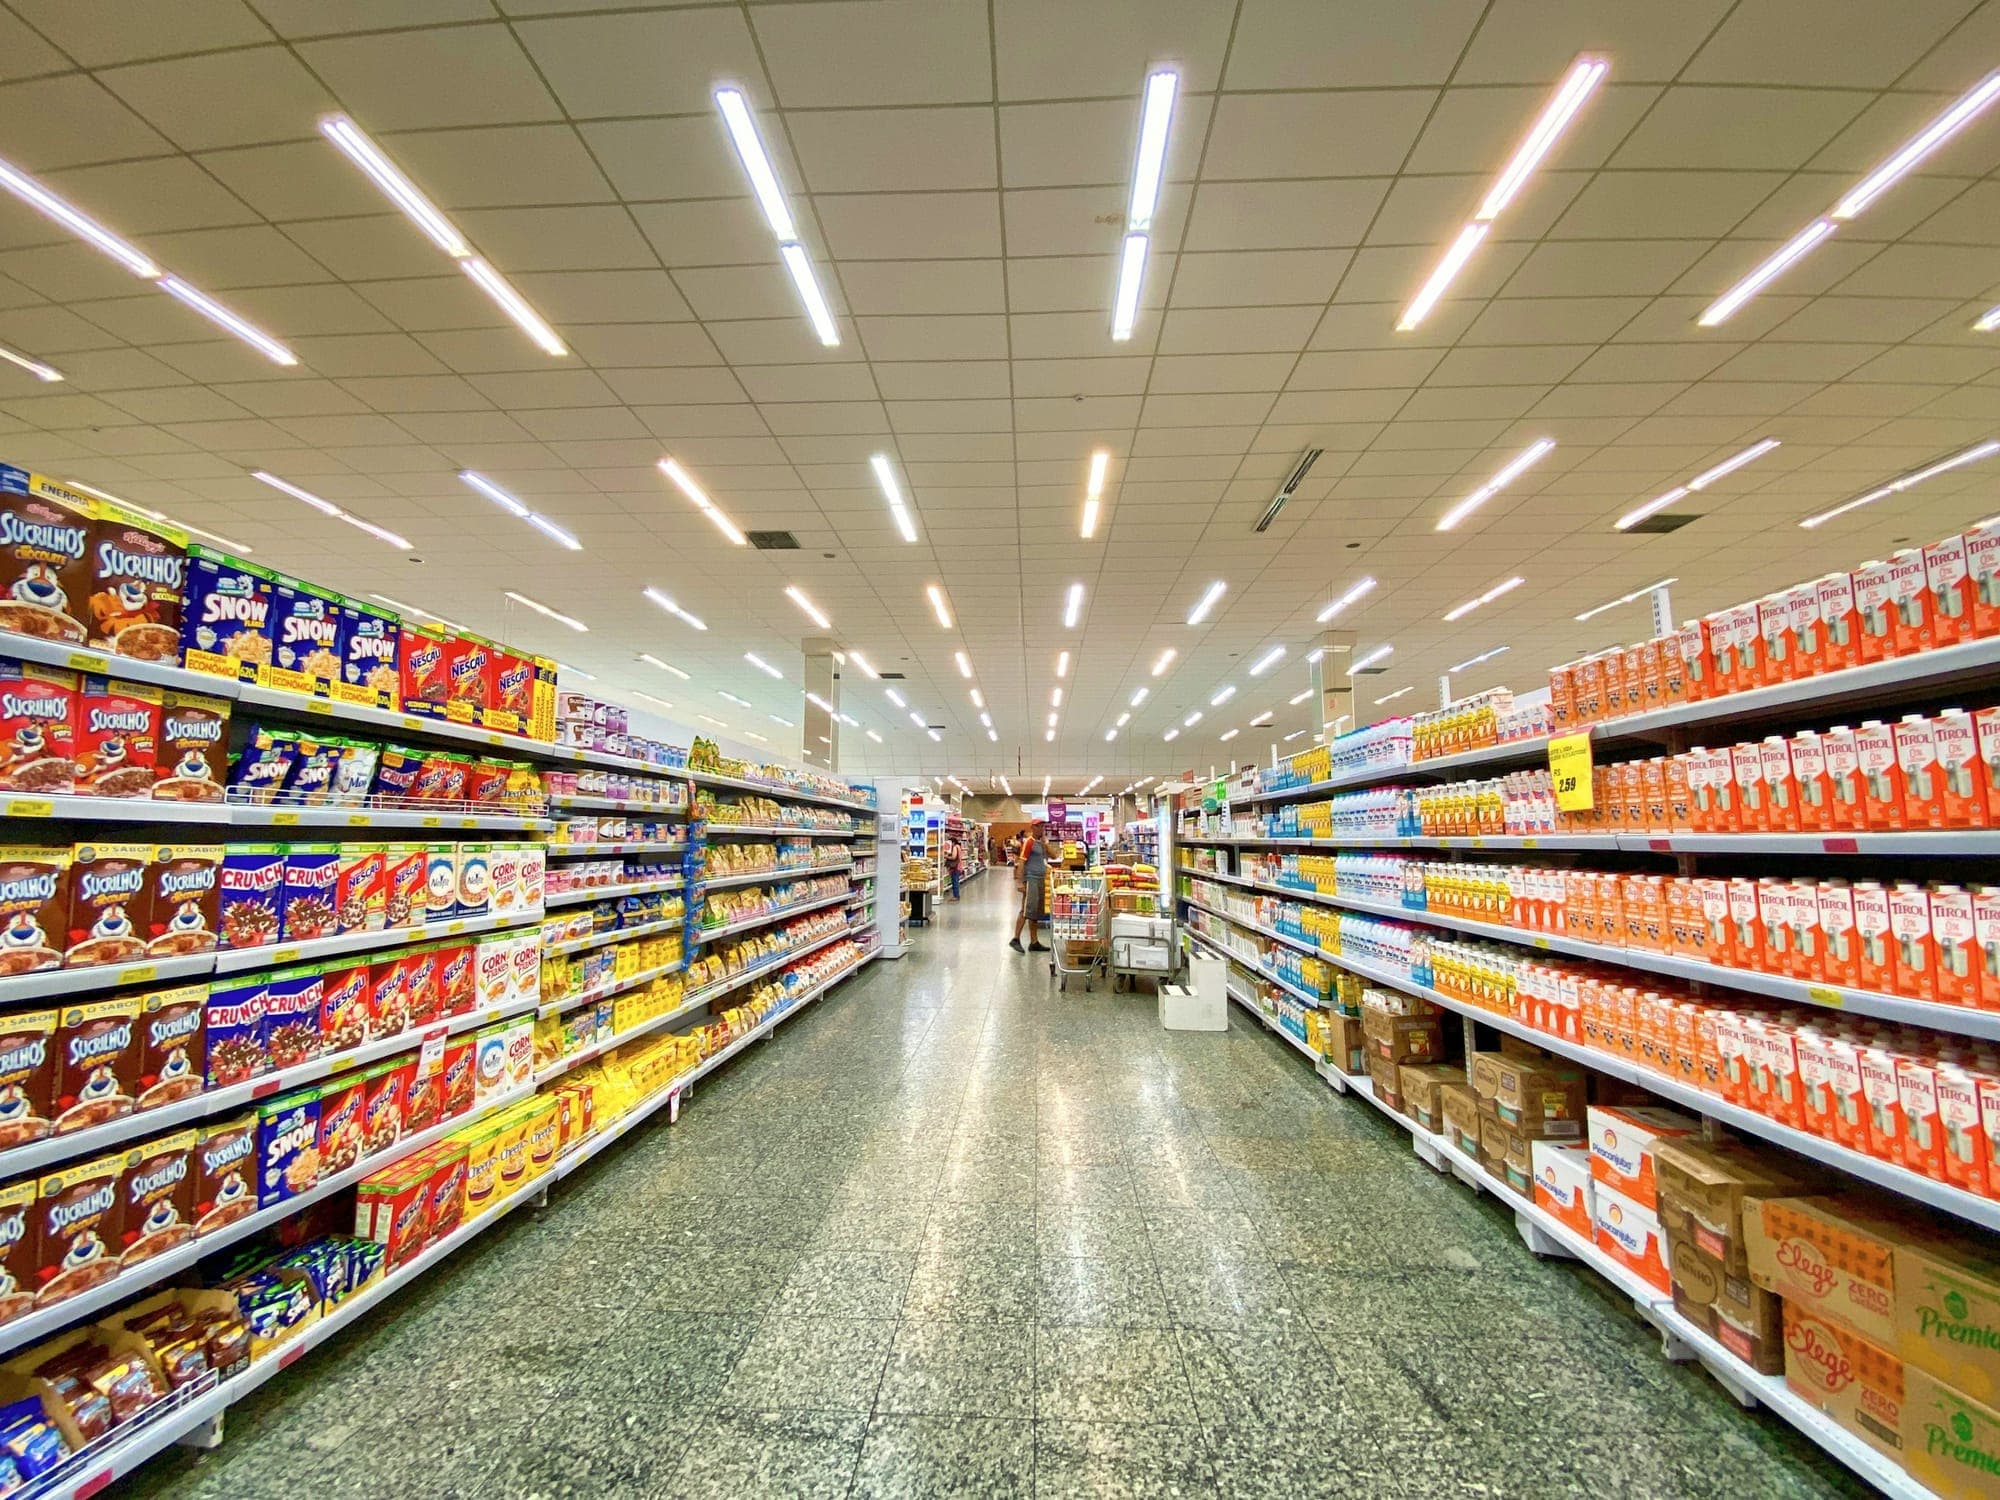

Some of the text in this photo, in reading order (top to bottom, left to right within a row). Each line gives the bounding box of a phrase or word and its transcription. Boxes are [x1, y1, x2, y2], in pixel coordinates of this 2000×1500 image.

[41, 482, 90, 507] ENERGIA
[1, 512, 87, 559] SUCRILHOS
[1968, 537, 2000, 555] TIRO
[99, 543, 184, 589] SUCRILHOS
[1928, 550, 1963, 568] TIROL
[1855, 574, 1888, 591] TIROL
[1889, 563, 1923, 581] TIROL
[1790, 596, 1817, 611] TIROL
[1820, 585, 1850, 601] TIROL
[203, 594, 268, 622] SNOW
[283, 617, 337, 643] SNOW
[350, 635, 396, 660] SNOW
[410, 648, 441, 672] NESCAU
[451, 652, 486, 678] NESCAU
[499, 667, 529, 691] NESCAU
[2, 693, 67, 720] SUCRILHOS
[89, 709, 150, 733] SUCRILHOS
[166, 718, 222, 742] SUCRILHOS
[1858, 739, 1892, 751] TIROL
[1898, 734, 1933, 747] TIROL
[1936, 728, 1971, 742] TIROL
[1793, 747, 1822, 760] TIROL
[1825, 744, 1855, 756] TIROL
[222, 861, 284, 888] CRUNCH
[285, 855, 340, 887] CRUNCH
[349, 860, 381, 890] NESCAU
[395, 859, 424, 886] NESCAU
[492, 861, 516, 880] CORN
[521, 861, 542, 877] CORN
[82, 868, 144, 900] SUCRILHOS
[161, 866, 216, 898] SUCRILHOS
[1786, 896, 1816, 909] TIROL
[1819, 898, 1849, 911] TIROL
[1855, 900, 1887, 914] TIROL
[1891, 903, 1926, 916] TIROL
[1933, 905, 1970, 919] TIROL
[482, 952, 507, 973] CORN
[514, 946, 536, 966] CORN
[443, 952, 472, 985] NESCAU
[326, 975, 366, 1018] NESCAU
[374, 966, 408, 1006] NESCAU
[207, 991, 270, 1027] CRUNCH
[268, 985, 324, 1014] CRUNCH
[151, 1008, 201, 1046] SUCRILHOS
[69, 1022, 132, 1066] SUCRILHOS
[509, 1035, 531, 1057] CORN
[1766, 1040, 1791, 1057] TIROL
[446, 1048, 473, 1083] NESCAU
[1800, 1048, 1827, 1065] TIROL
[1827, 1056, 1857, 1075] TIROL
[1862, 1065, 1896, 1085] TIROL
[1899, 1075, 1933, 1095] TIROL
[367, 1076, 400, 1121] NESCAU
[1938, 1086, 1976, 1107] TIROL
[322, 1092, 362, 1143] NESCAU
[204, 1132, 253, 1176] SUCRILHOS
[269, 1120, 317, 1166] SNOW
[131, 1154, 189, 1204] SUCRILHOS
[434, 1164, 464, 1207] NESCAU
[49, 1181, 115, 1236] SUCRILHOS
[396, 1183, 429, 1232] NESCAU
[1848, 1278, 1889, 1307] ZERO
